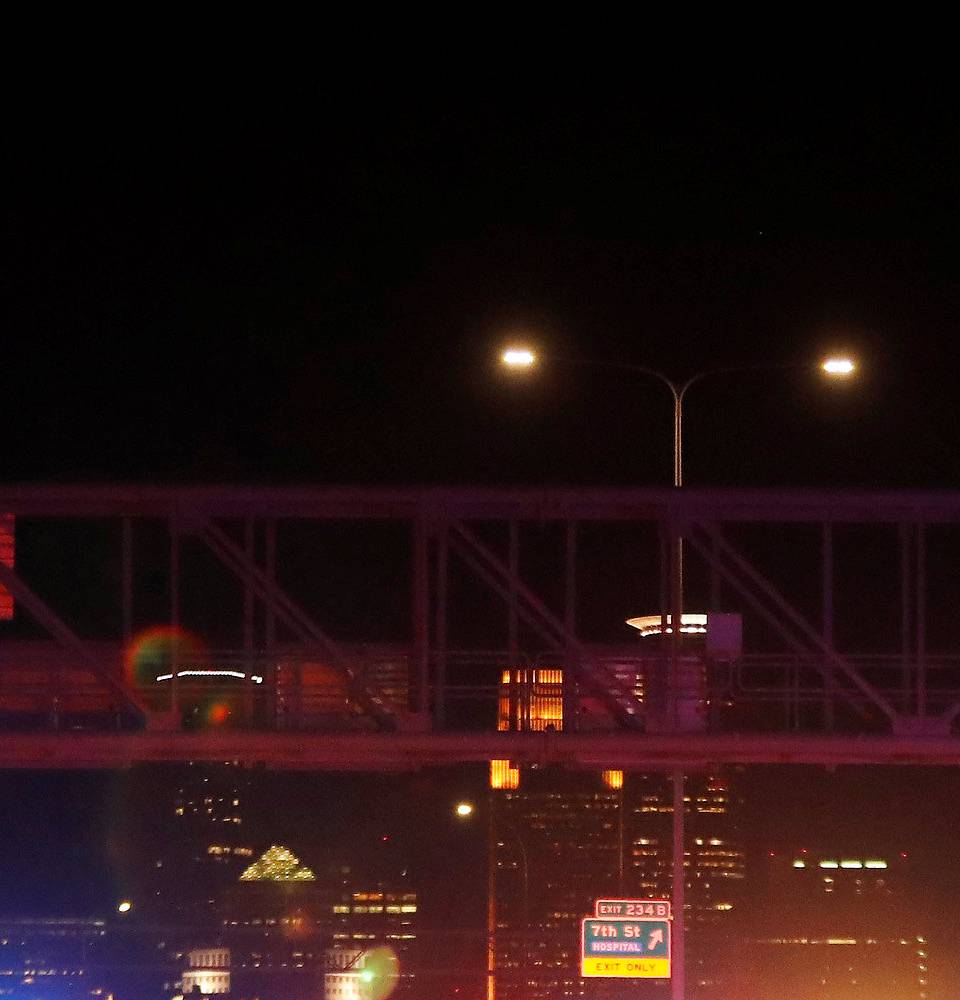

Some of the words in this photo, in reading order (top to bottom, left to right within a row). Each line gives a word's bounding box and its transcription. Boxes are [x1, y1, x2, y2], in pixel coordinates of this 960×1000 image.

[600, 905, 622, 914] EXIT
[626, 904, 654, 916] 234
[656, 905, 667, 916] B
[591, 924, 618, 937] 7th
[624, 924, 641, 938] St
[591, 942, 641, 952] HOSPITAL
[596, 963, 620, 971] EXIT
[626, 963, 656, 972] ONLY
